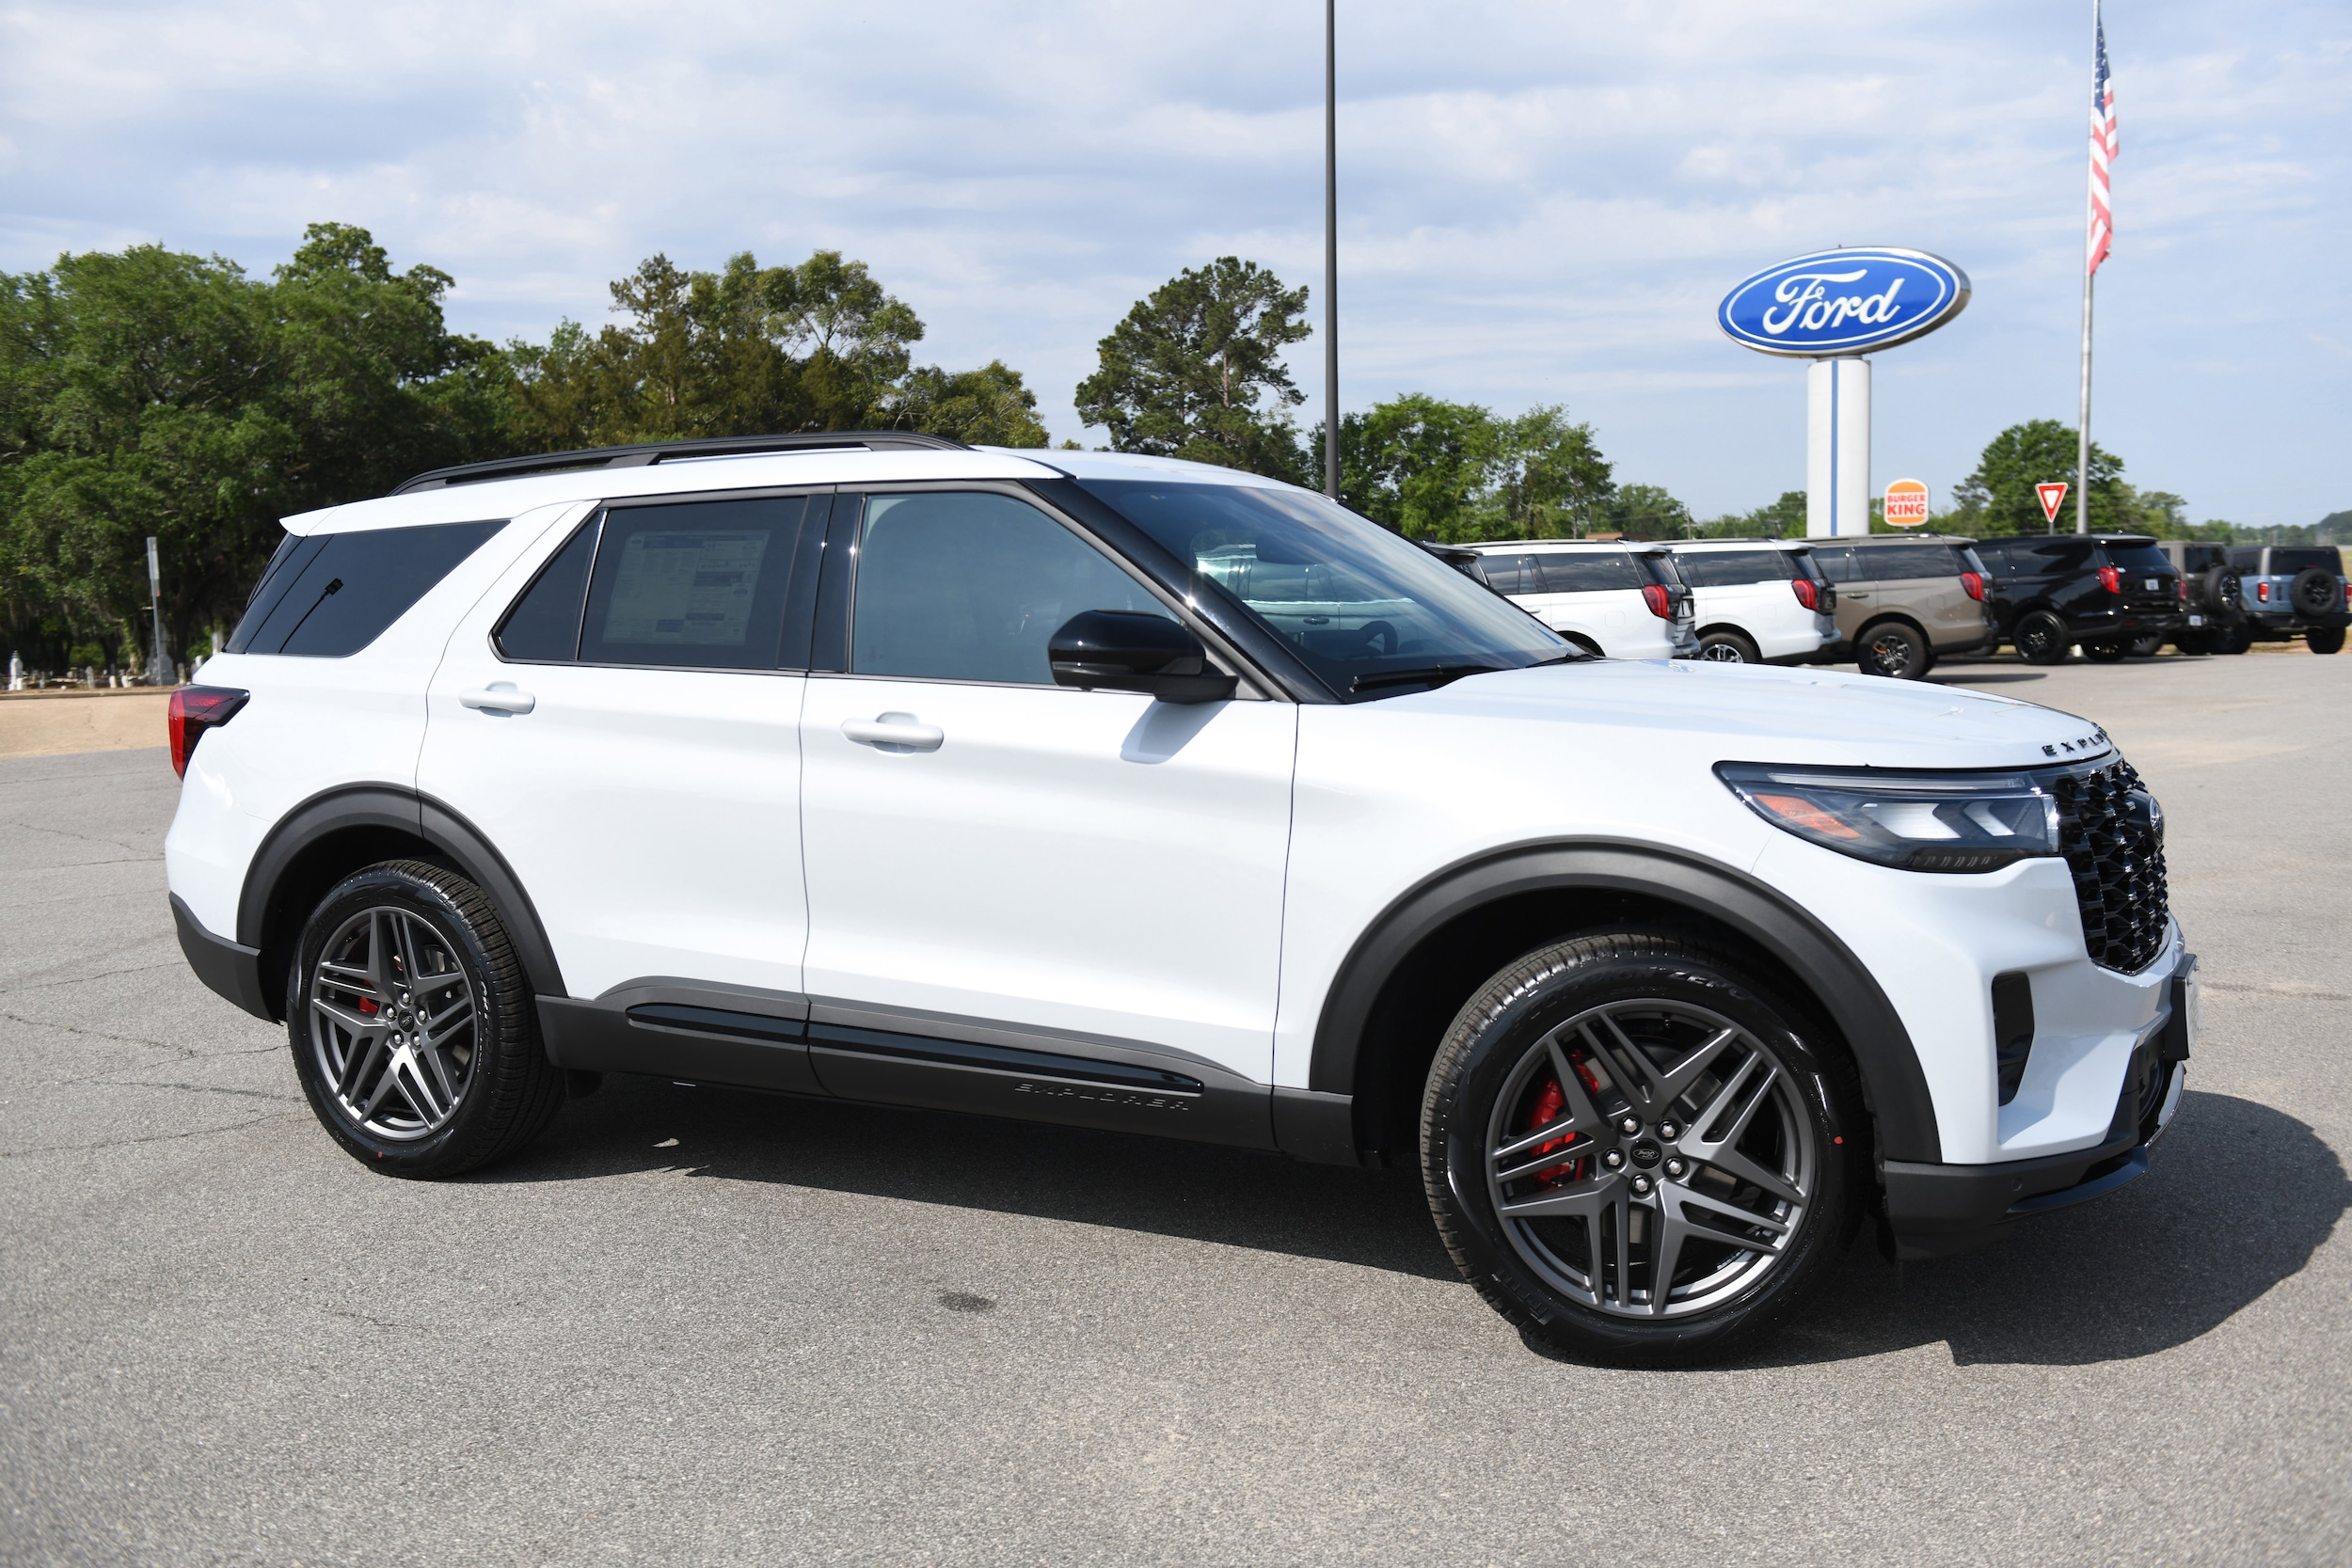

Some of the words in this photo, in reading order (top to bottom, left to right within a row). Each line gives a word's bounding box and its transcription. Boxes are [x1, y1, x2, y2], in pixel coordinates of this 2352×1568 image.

[1762, 269, 1905, 335] Ford
[1887, 494, 1926, 503] BURGER
[1887, 503, 1926, 515] KING
[1015, 1083, 1188, 1110] EXPLORER
